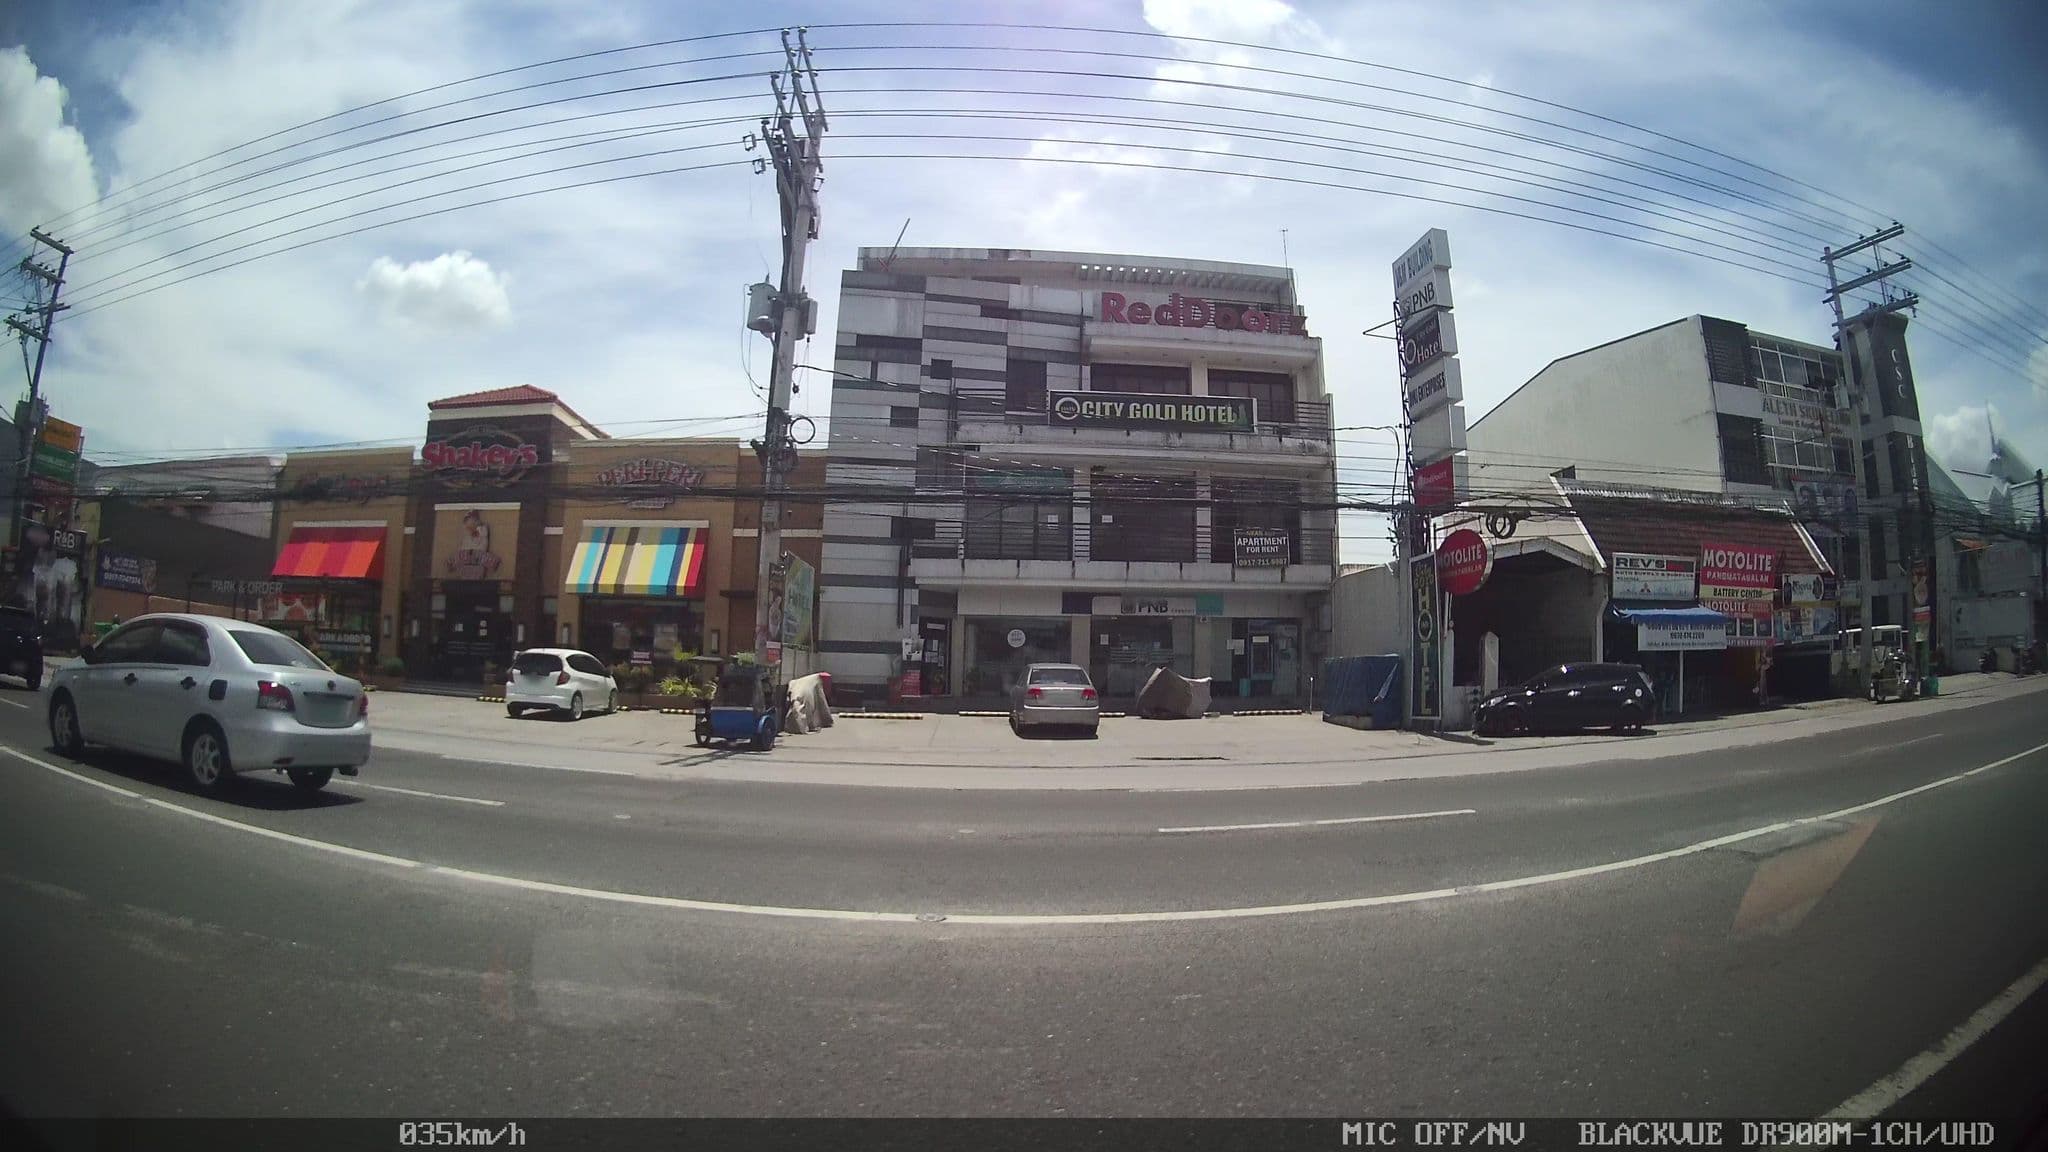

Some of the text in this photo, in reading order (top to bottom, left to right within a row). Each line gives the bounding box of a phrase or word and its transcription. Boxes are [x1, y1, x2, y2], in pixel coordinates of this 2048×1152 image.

[1412, 282, 1435, 313] PNB
[1102, 291, 1308, 335] RedDoorz
[1417, 334, 1442, 364] Hotel
[1081, 400, 1122, 417] CITY
[1127, 402, 1179, 420] GOLD
[1181, 404, 1237, 424] HOTEL
[1237, 537, 1287, 546] APARTMENT
[1246, 545, 1279, 554] FOR RENT
[1703, 549, 1772, 572] MOTOLITE
[1713, 588, 1738, 598] BATTERY
[1138, 601, 1168, 613] PNB
